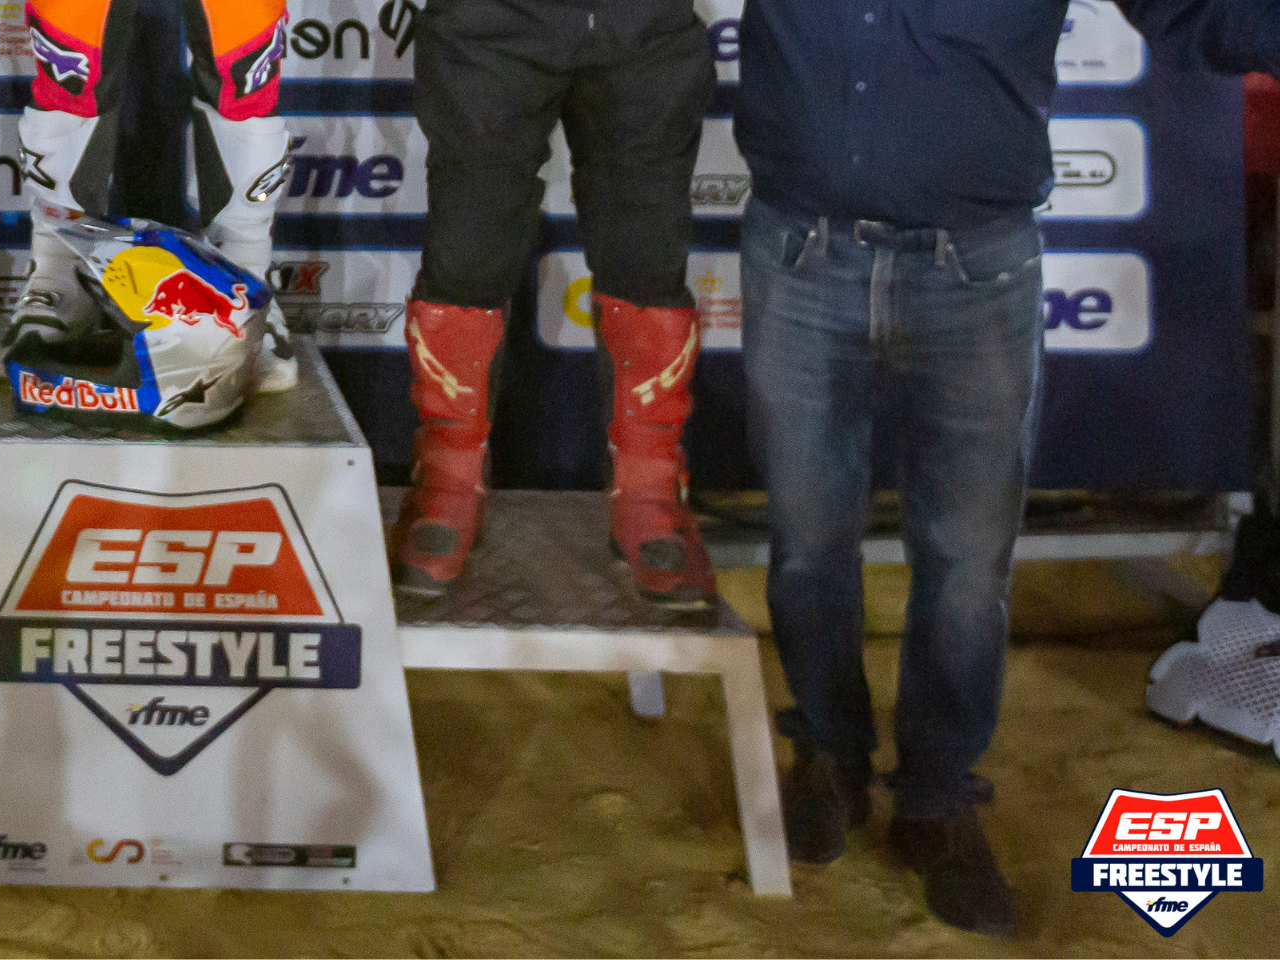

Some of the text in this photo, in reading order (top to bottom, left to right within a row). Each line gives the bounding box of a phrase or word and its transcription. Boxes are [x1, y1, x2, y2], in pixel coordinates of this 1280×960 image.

[20, 371, 139, 411] Red Bull
[65, 528, 282, 586] ESP
[61, 588, 279, 609] CAMPEONATO DE ESPAÑA
[21, 627, 321, 680] FREESTYLE
[126, 696, 210, 727] rfme
